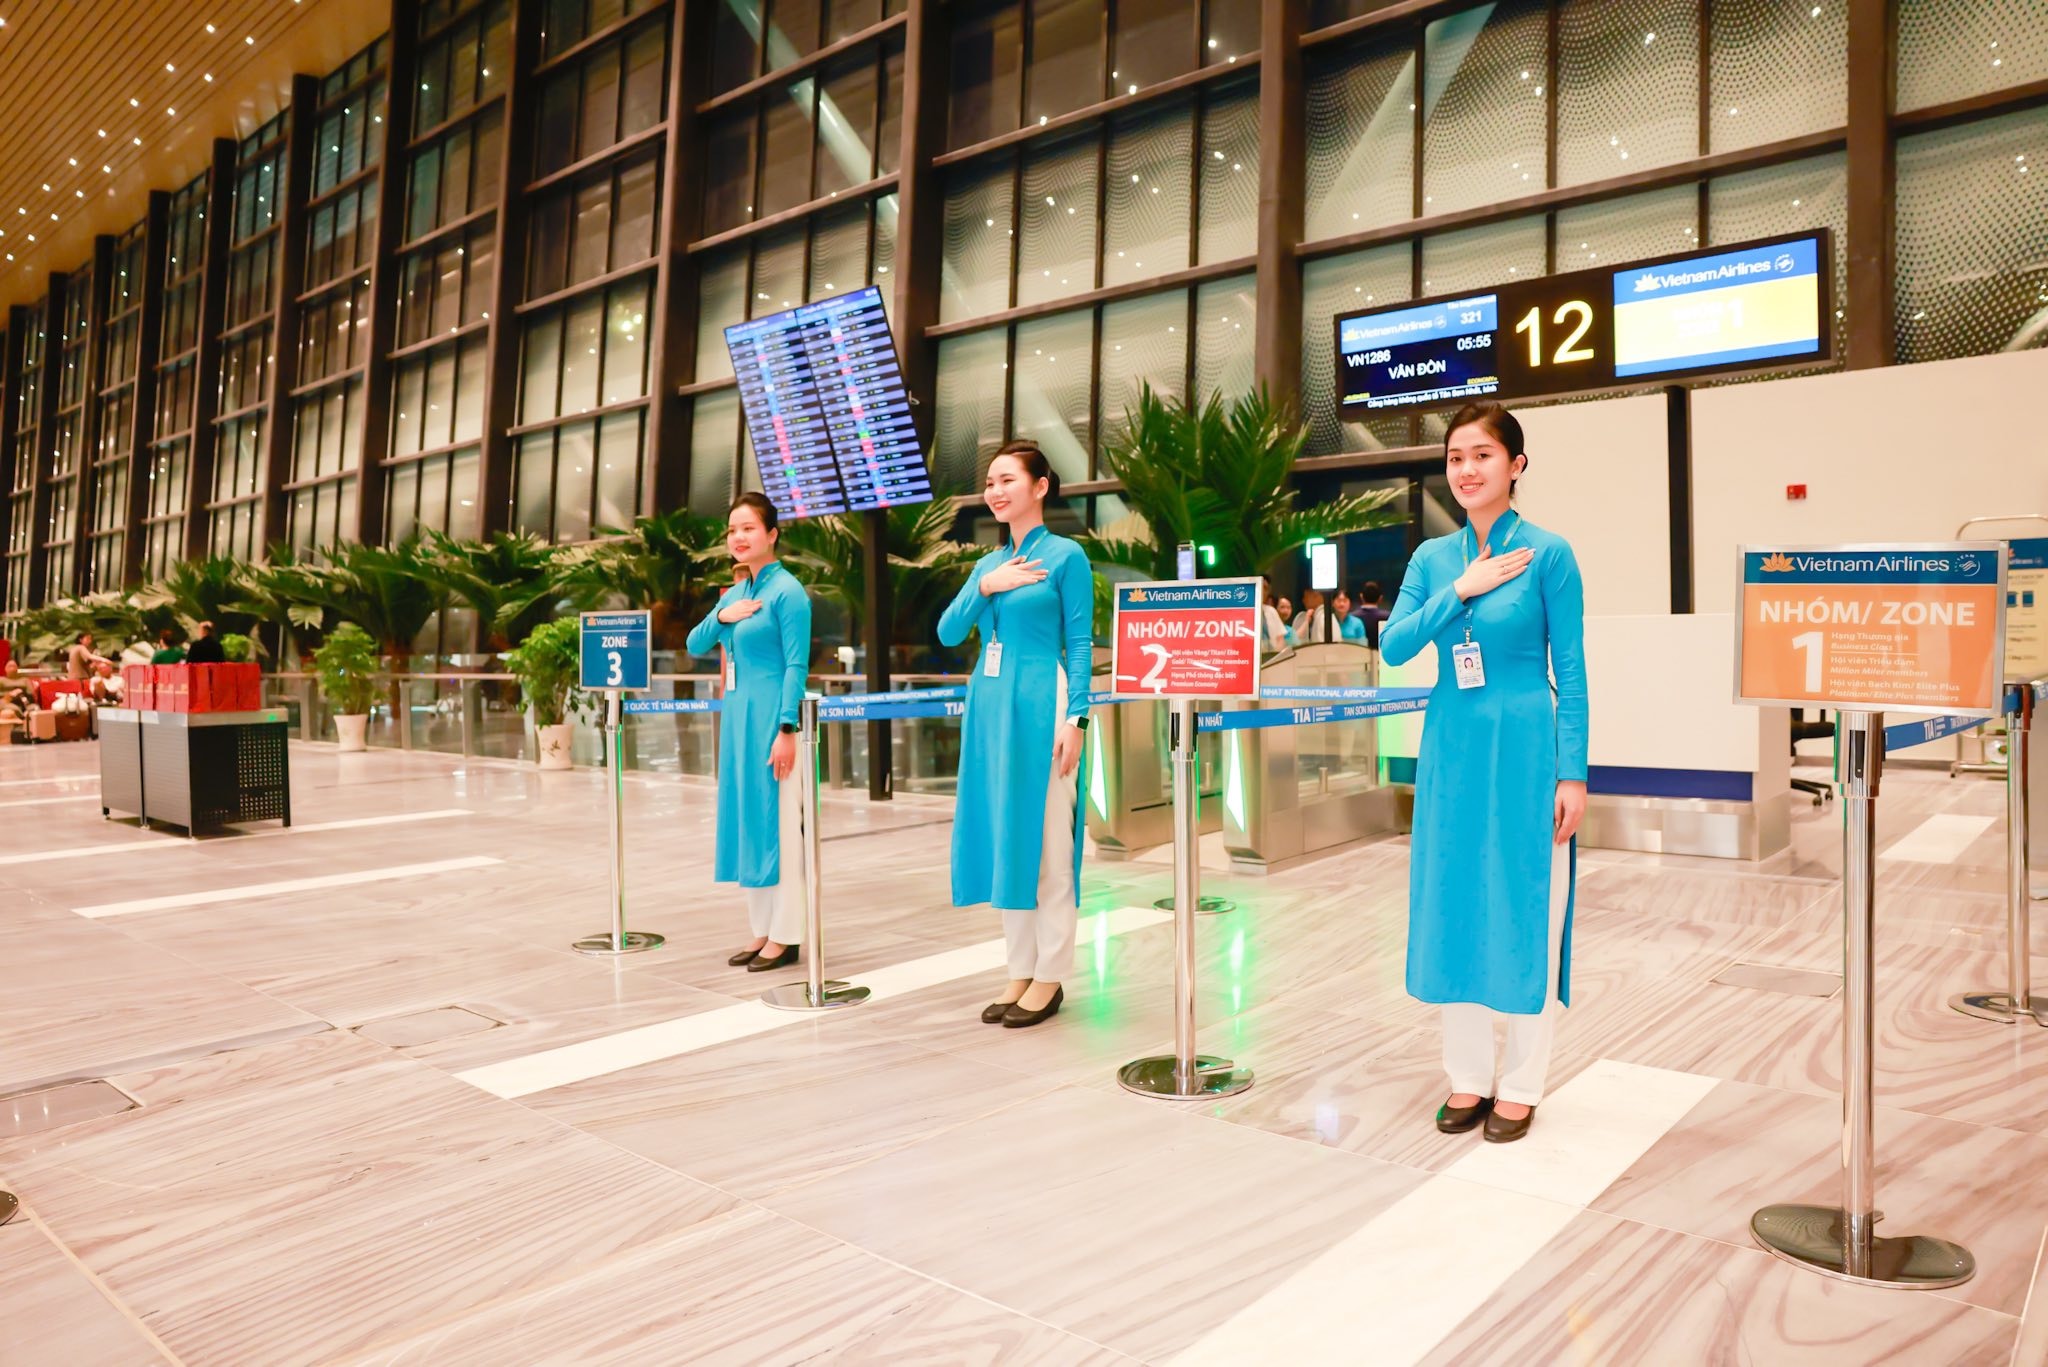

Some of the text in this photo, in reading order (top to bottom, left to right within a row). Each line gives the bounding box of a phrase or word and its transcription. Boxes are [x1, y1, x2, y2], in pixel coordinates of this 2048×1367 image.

[1659, 260, 1771, 289] Vietnam Airlines
[1460, 311, 1482, 325] 321
[1359, 320, 1433, 339] Vietnam Airlines
[1515, 300, 1594, 367] 12
[1457, 334, 1491, 351] 05:55
[1347, 350, 1391, 367] VN1286
[1796, 556, 1950, 572] Vietnam Airlines
[1148, 589, 1232, 602] Vietnam Airlines
[1760, 596, 1975, 626] NHÓM/ ZONE
[596, 617, 636, 626] Vietnam Airlines
[1127, 618, 1245, 639] NHÓM/ ZONE
[602, 636, 628, 648] ZONE
[1831, 642, 1893, 651] Business Class
[606, 651, 623, 686] 3
[1140, 643, 1168, 688] 2
[1792, 631, 1824, 693] 1
[1830, 666, 1860, 675] Million
[1284, 689, 1341, 697] INTERNATIONAL
[1343, 689, 1377, 698] AIRPORT
[1940, 682, 1960, 691] Plus
[1292, 708, 1311, 723] TIA
[1344, 706, 1354, 716] TAN
[1355, 705, 1365, 716] SON
[1366, 704, 1380, 714] NHAT
[1381, 700, 1416, 713] INTERNATIONAL
[1924, 718, 1934, 741] TIA
